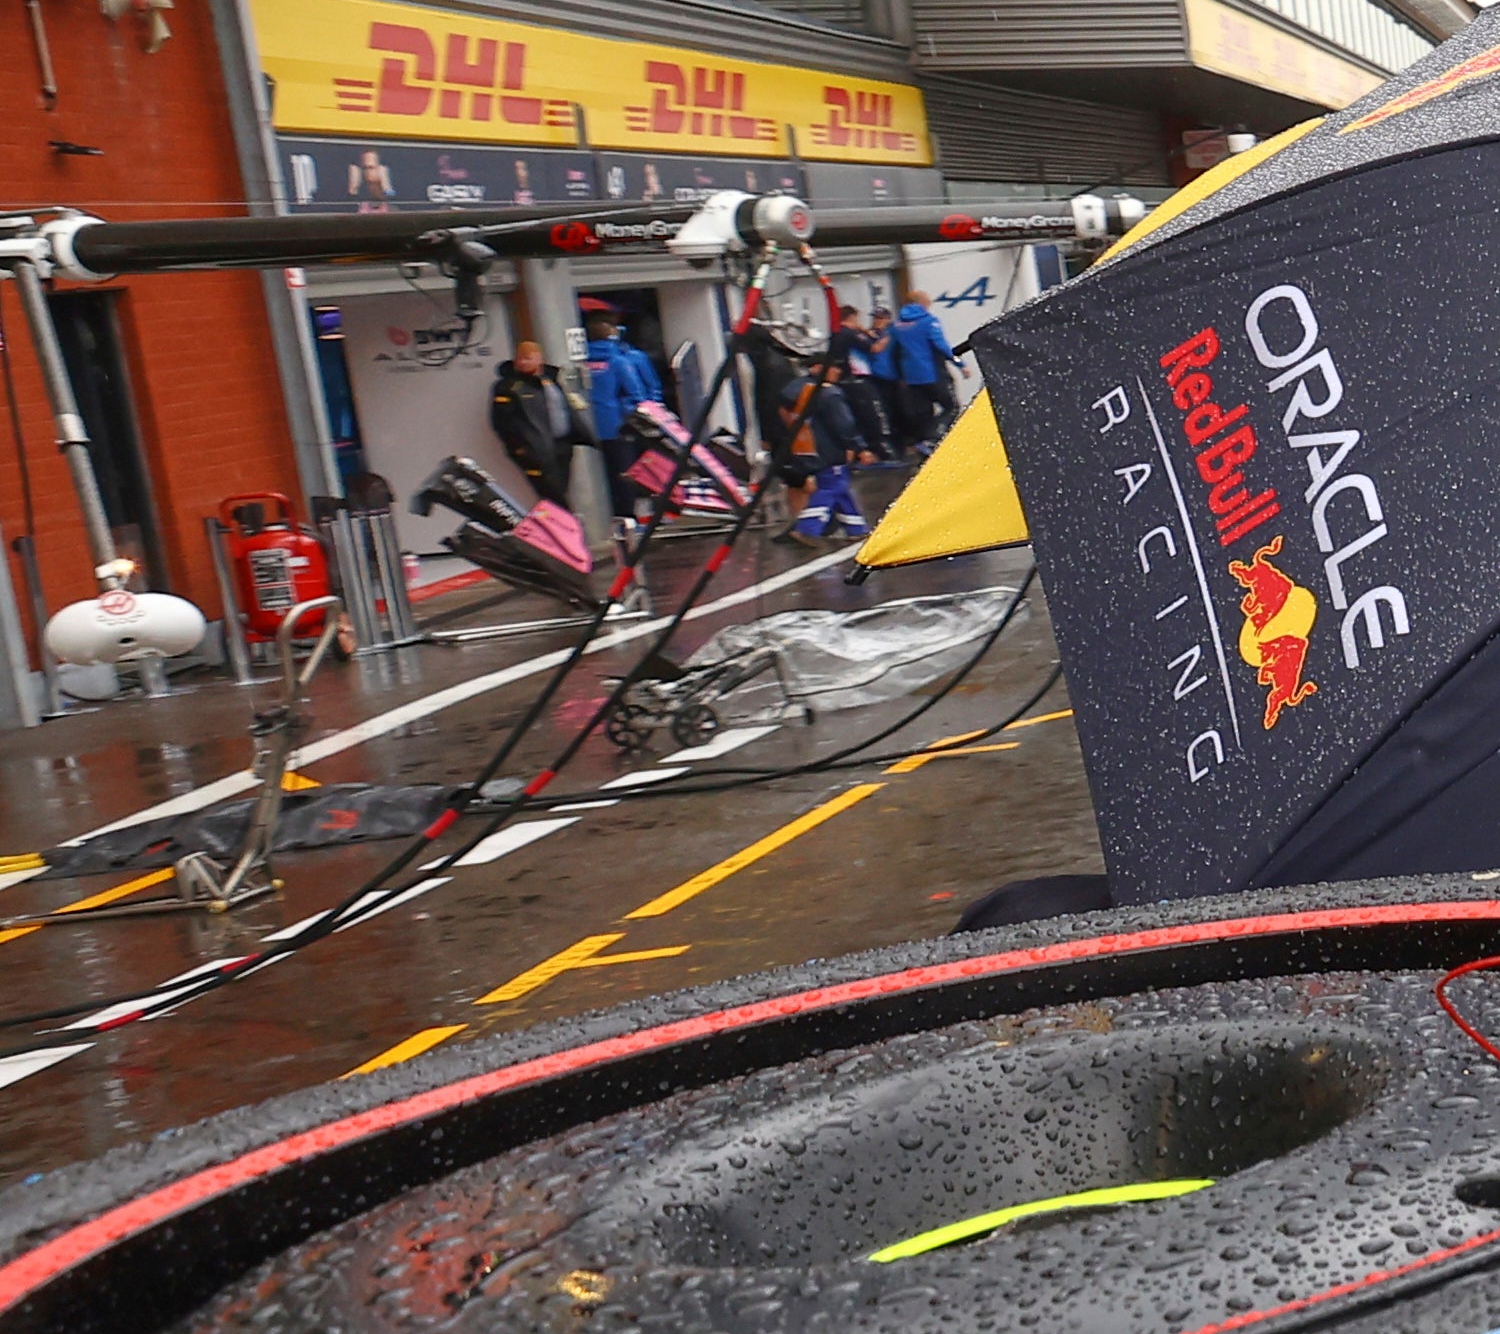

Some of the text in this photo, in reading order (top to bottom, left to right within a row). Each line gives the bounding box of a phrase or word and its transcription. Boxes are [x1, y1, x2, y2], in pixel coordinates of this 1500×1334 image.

[368, 21, 543, 124] DHL
[644, 60, 758, 140] DHL
[822, 85, 900, 151] DHL
[1244, 283, 1411, 670] ORACLE
[1091, 384, 1226, 784] RACING
